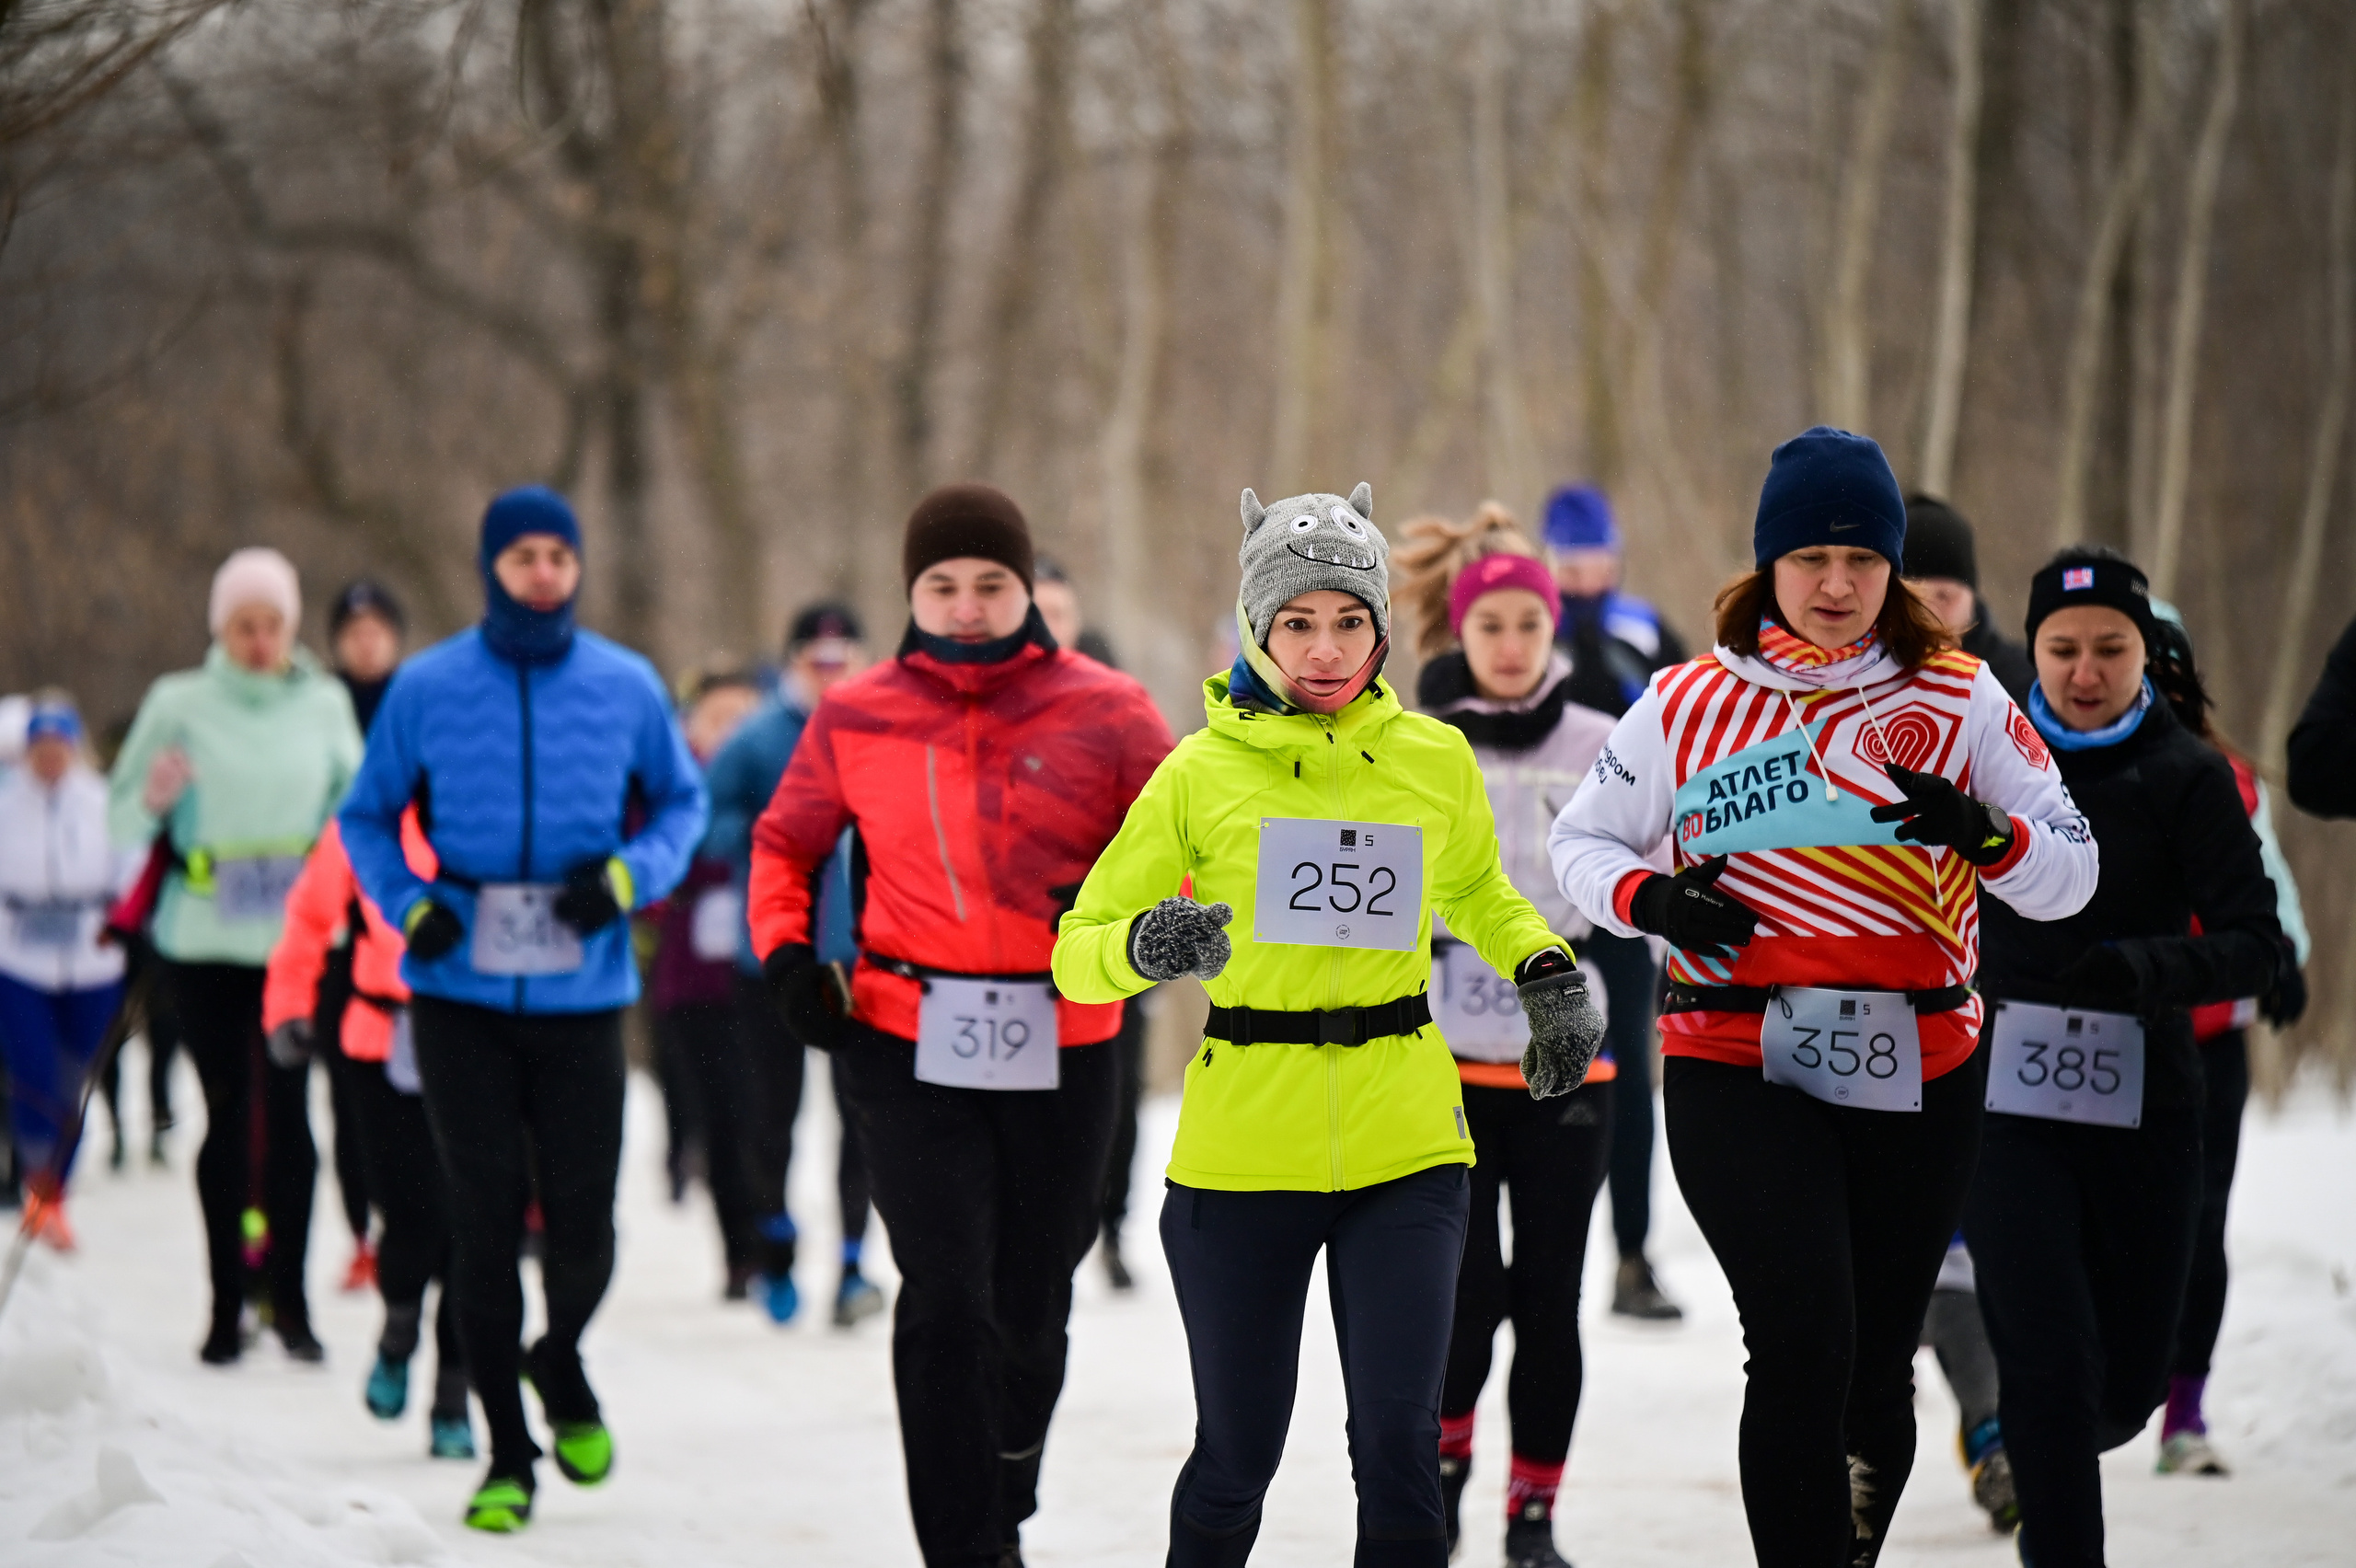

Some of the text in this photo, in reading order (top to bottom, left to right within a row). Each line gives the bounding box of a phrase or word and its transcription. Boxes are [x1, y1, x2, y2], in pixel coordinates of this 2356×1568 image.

[1707, 750, 1800, 804] АТЛЕТ
[1289, 861, 1396, 917] 252
[951, 1017, 1031, 1061] 319
[1792, 1027, 1898, 1079] 358
[2017, 1041, 2121, 1095] 385
